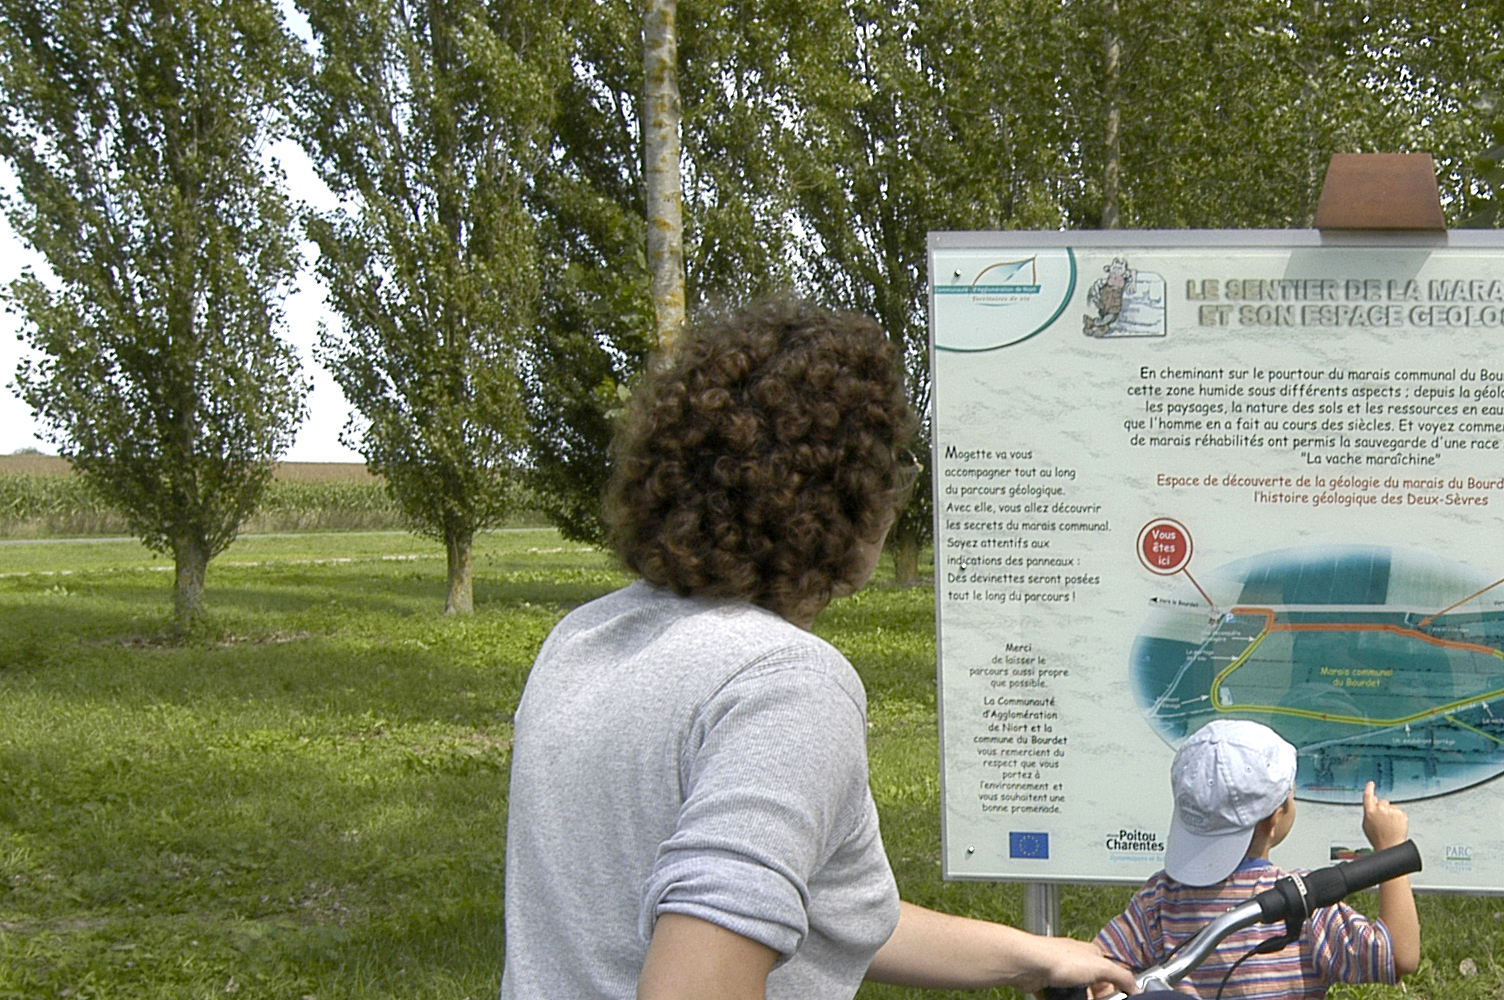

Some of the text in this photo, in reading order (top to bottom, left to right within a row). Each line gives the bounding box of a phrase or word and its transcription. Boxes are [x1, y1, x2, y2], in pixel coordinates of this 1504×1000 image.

[1187, 280, 1220, 300] LE
[1224, 279, 1340, 301] SENTIER
[1345, 279, 1383, 300] DE
[1387, 279, 1420, 301] LA
[1199, 305, 1233, 327] ET
[1238, 305, 1296, 327] SON
[1300, 305, 1404, 327] ESPACE
[1140, 366, 1156, 379] En
[1160, 366, 1224, 379] cheminant
[1228, 370, 1249, 379] sur
[1253, 367, 1264, 379] le
[1268, 369, 1324, 383] pourtour
[1328, 367, 1344, 380] du
[1348, 368, 1390, 380] marais
[1394, 368, 1456, 381] communal
[1460, 368, 1476, 381] du
[1127, 385, 1162, 396] cette
[1166, 387, 1195, 396] zone
[1199, 383, 1244, 396] humide
[1248, 387, 1276, 396] sous
[1280, 384, 1348, 397] différents
[1352, 386, 1401, 400] aspects
[1414, 385, 1455, 401] depuis
[1459, 385, 1470, 398] la
[1146, 400, 1163, 413] les
[1167, 403, 1227, 416] paysages,
[1232, 400, 1242, 413] la
[1246, 402, 1288, 413] nature
[1292, 401, 1314, 413] des
[1319, 401, 1343, 414] sols
[1347, 403, 1361, 414] et
[1366, 401, 1383, 414] les
[1388, 405, 1458, 415] ressources
[1462, 406, 1477, 415] en
[1124, 420, 1145, 432] que
[1150, 416, 1202, 430] l'homme
[1206, 421, 1221, 430] en
[1225, 421, 1232, 430] a
[1236, 417, 1260, 430] fait
[1264, 421, 1278, 430] au
[1282, 421, 1317, 430] cours
[1321, 419, 1343, 431] des
[1348, 418, 1394, 431] siècles.
[1399, 419, 1413, 432] Et
[1418, 423, 1454, 435] voyez
[1130, 434, 1146, 446] de
[1150, 434, 1191, 446] marais
[1195, 434, 1264, 447] réhabilités
[1268, 436, 1289, 447] ont
[1292, 435, 1335, 451] permis
[1340, 434, 1350, 447] la
[1355, 436, 1427, 452] sauvegarde
[1431, 435, 1467, 449] d'une
[1471, 440, 1499, 449] race
[945, 445, 1033, 462] Mogette va vous
[945, 466, 1076, 481] accompagner tout au long
[1157, 473, 1199, 489] Espace
[1203, 474, 1219, 486] de
[1222, 473, 1292, 487] découverte
[1296, 475, 1311, 487] de
[1315, 474, 1325, 487] la
[1329, 475, 1380, 491] géologie
[1384, 476, 1399, 489] du
[1403, 477, 1444, 492] marais
[1448, 476, 1463, 489] du
[946, 484, 1065, 498] du parcours géologique.
[1254, 491, 1488, 507] l'histoire géologique des Deux-Sèvres
[946, 502, 1101, 514] Avec elle, vous allez découvrir
[946, 519, 1111, 532] les secrets du marais communal.
[1152, 530, 1176, 540] Vous
[947, 537, 978, 550] Soyez
[981, 538, 1028, 548] attentifs
[1152, 542, 1176, 552] êtes
[1158, 555, 1170, 565] ici
[1005, 643, 1032, 652] Merci
[1321, 667, 1350, 676] Marais
[1333, 678, 1342, 686] du
[984, 696, 1056, 706] La Communauté
[973, 735, 1067, 745] commune du Bourdet
[1120, 830, 1156, 841] Poitou
[1106, 838, 1164, 852] Charentes
